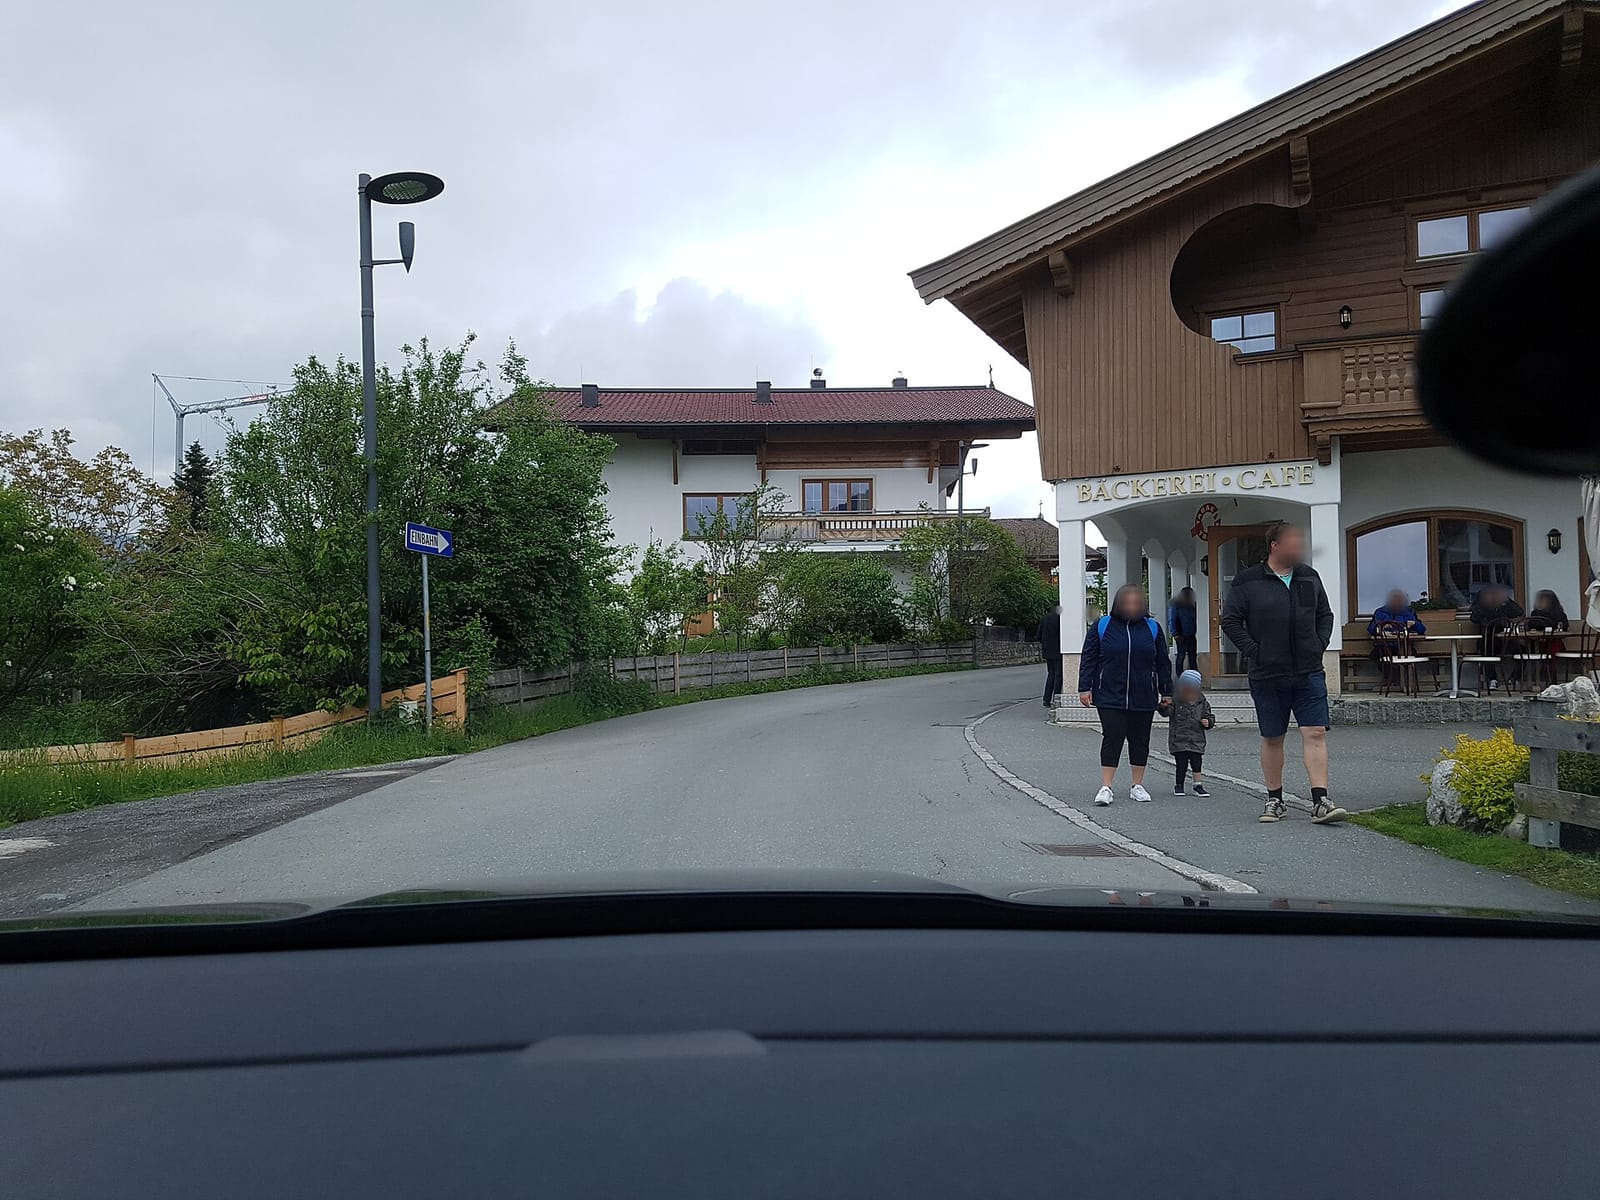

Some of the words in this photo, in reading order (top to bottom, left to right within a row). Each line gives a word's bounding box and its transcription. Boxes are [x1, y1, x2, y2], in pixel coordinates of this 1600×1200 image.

[1076, 473, 1217, 503] BÄCKEREI
[1237, 464, 1314, 490] CAFE
[411, 531, 438, 547] EINBAHN
